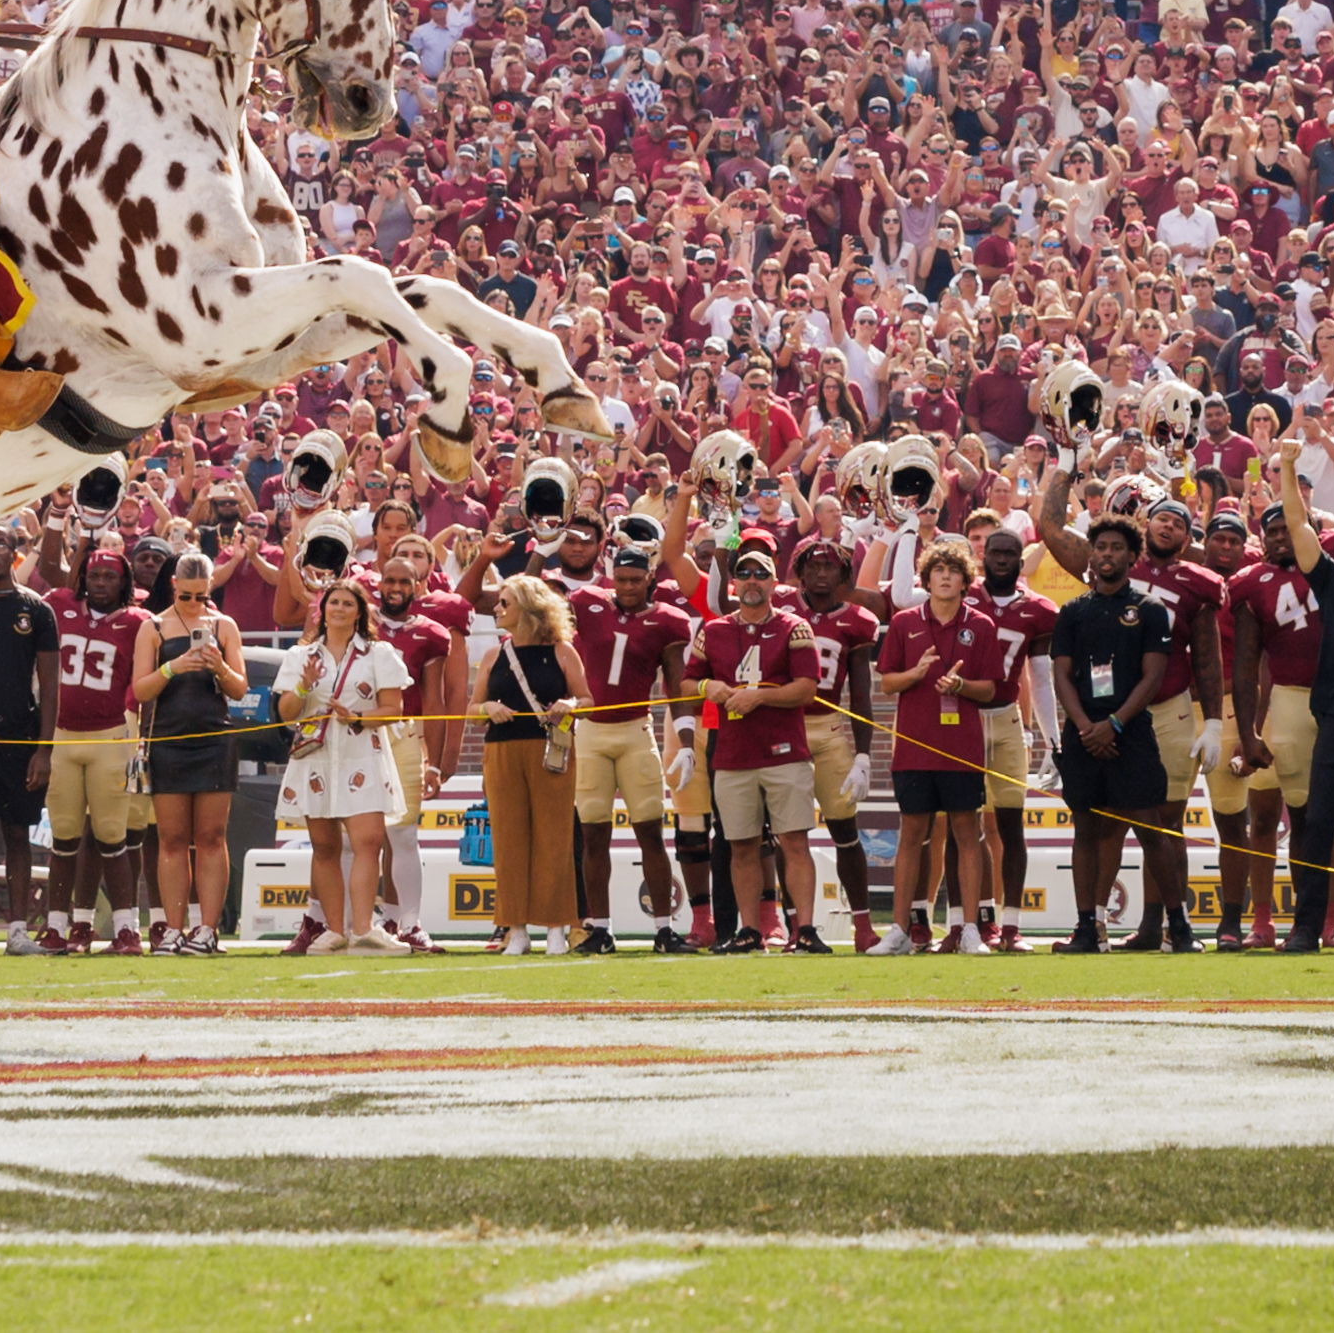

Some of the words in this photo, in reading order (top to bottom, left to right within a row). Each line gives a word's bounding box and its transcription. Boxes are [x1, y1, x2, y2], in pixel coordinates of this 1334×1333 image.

[292, 180, 324, 211] 80
[625, 289, 656, 314] FS
[1211, 451, 1222, 469] 1
[60, 633, 117, 692] 33
[607, 630, 629, 686] 1
[734, 644, 763, 691] 4
[997, 626, 1026, 682] 7
[262, 889, 310, 905] DEWA
